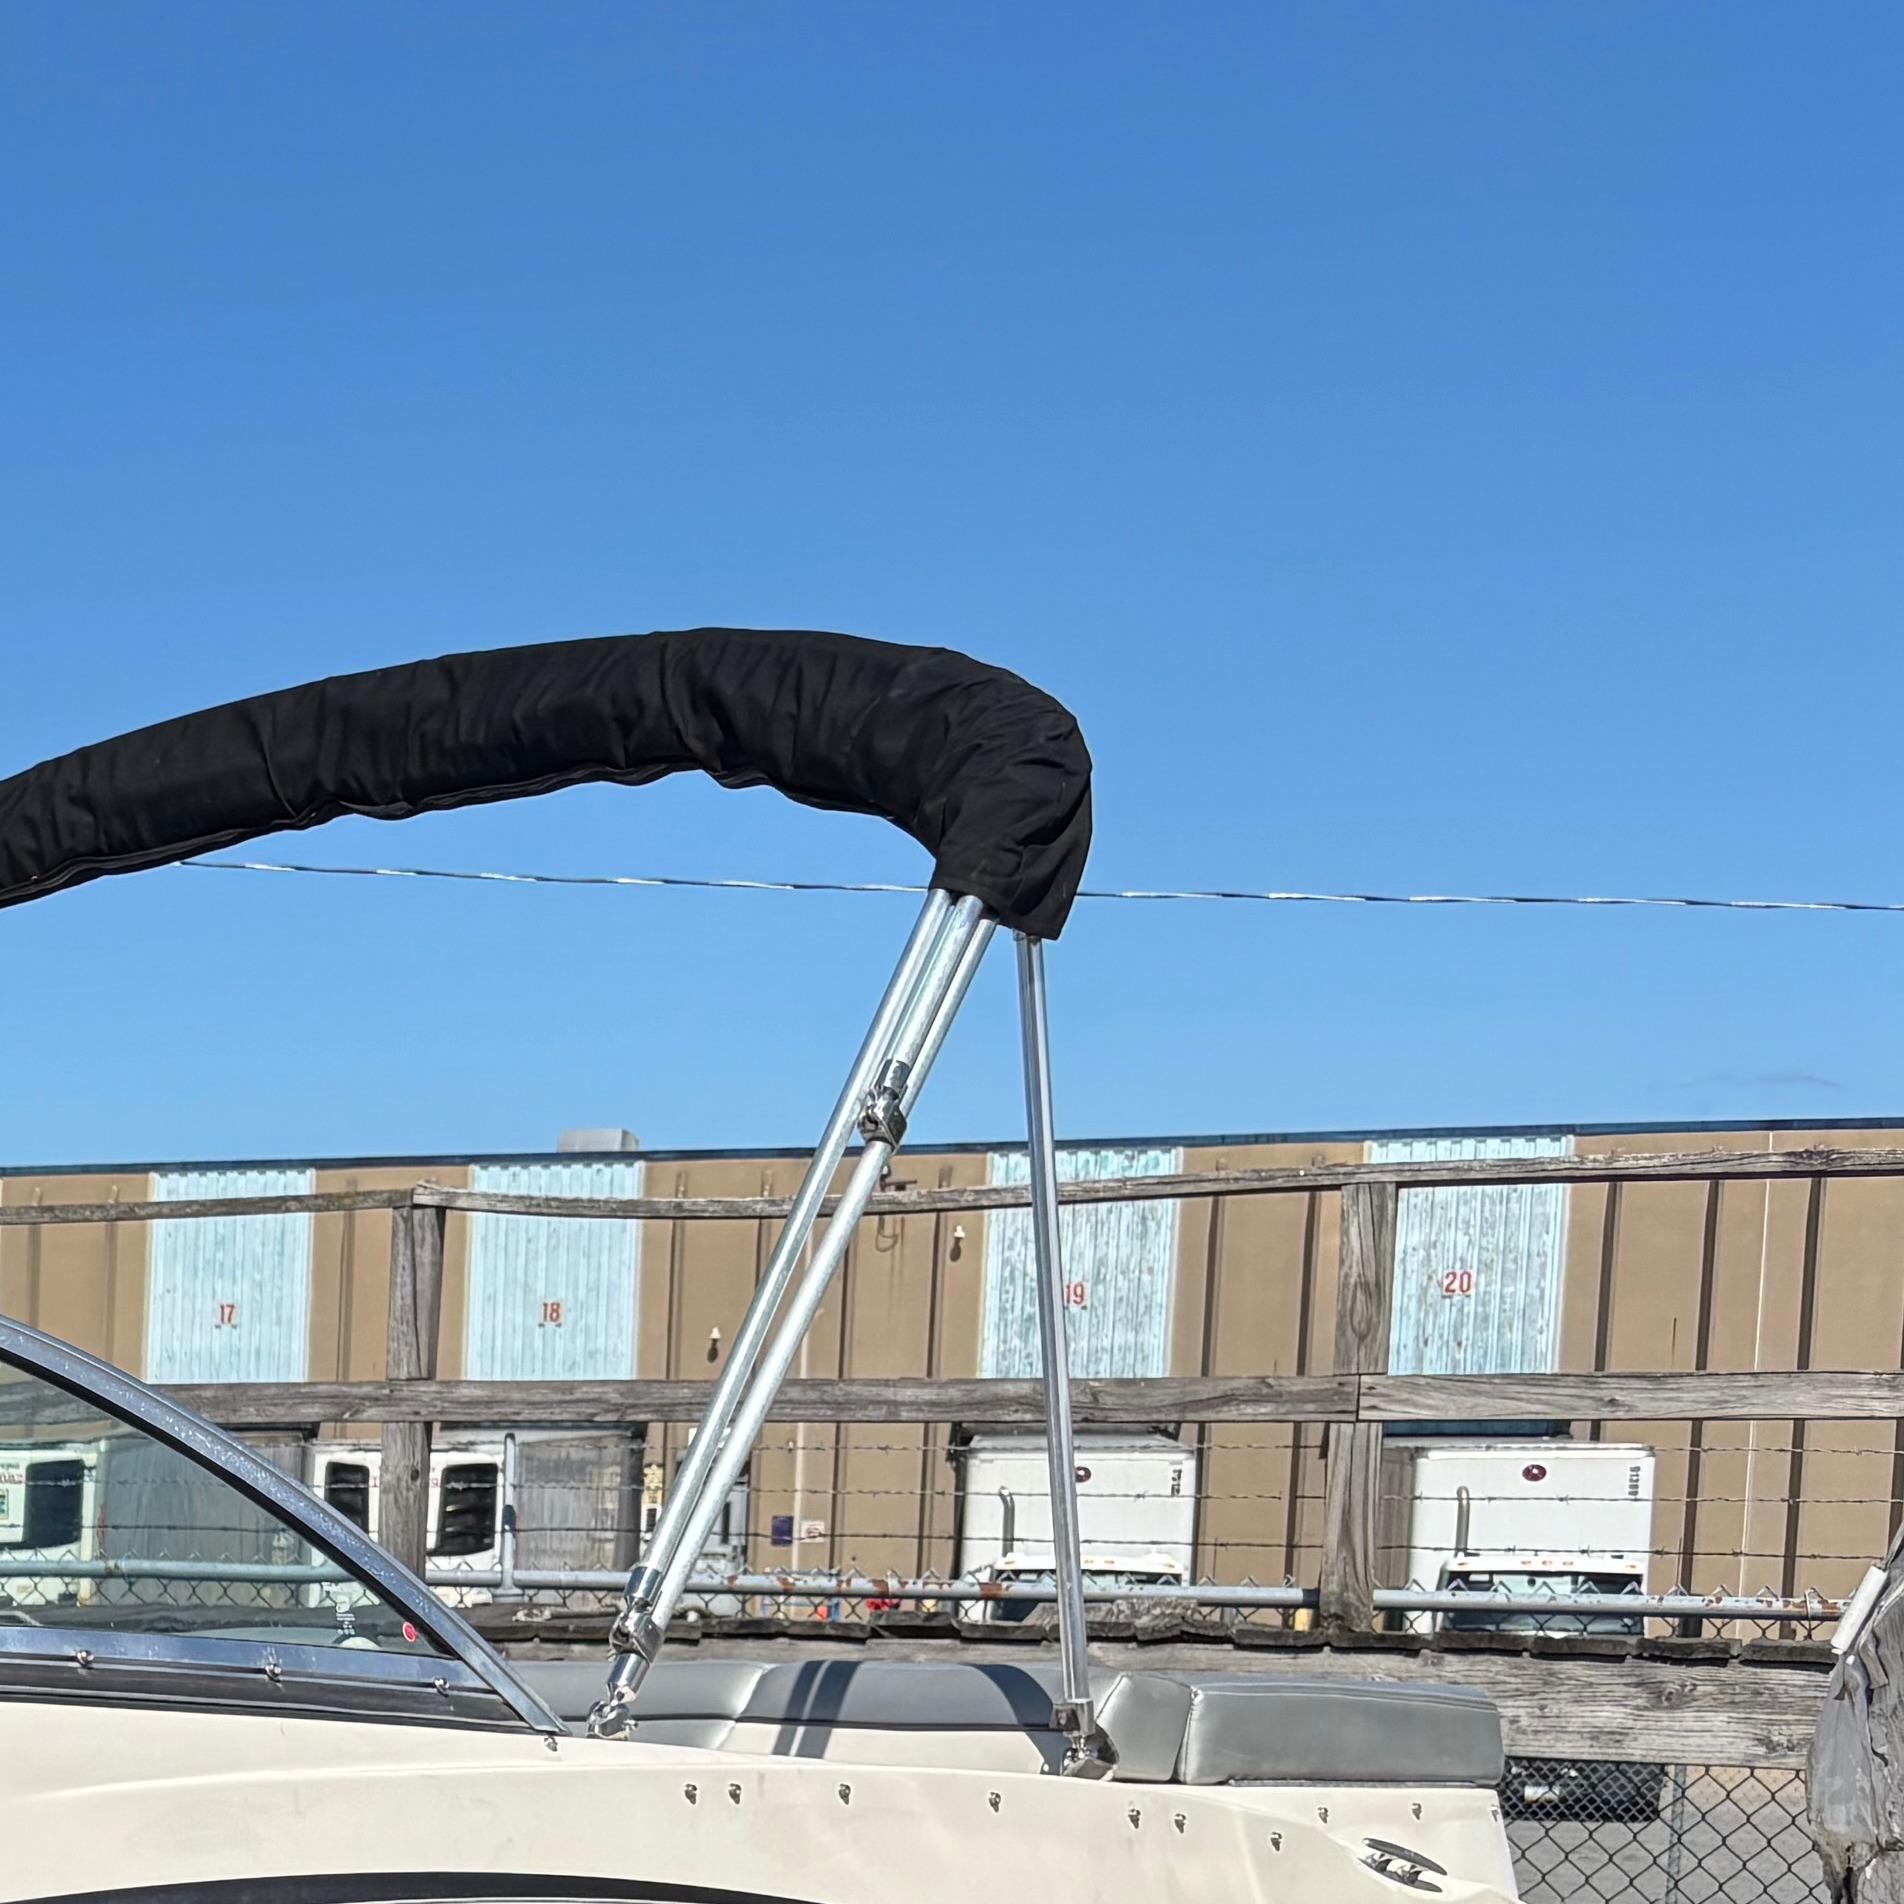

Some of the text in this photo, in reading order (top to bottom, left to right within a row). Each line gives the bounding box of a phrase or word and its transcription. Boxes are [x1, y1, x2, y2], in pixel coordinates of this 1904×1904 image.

[1444, 1270, 1472, 1293] 20
[1065, 1283, 1085, 1305] 19
[219, 1303, 235, 1324] 17
[542, 1302, 560, 1322] 18
